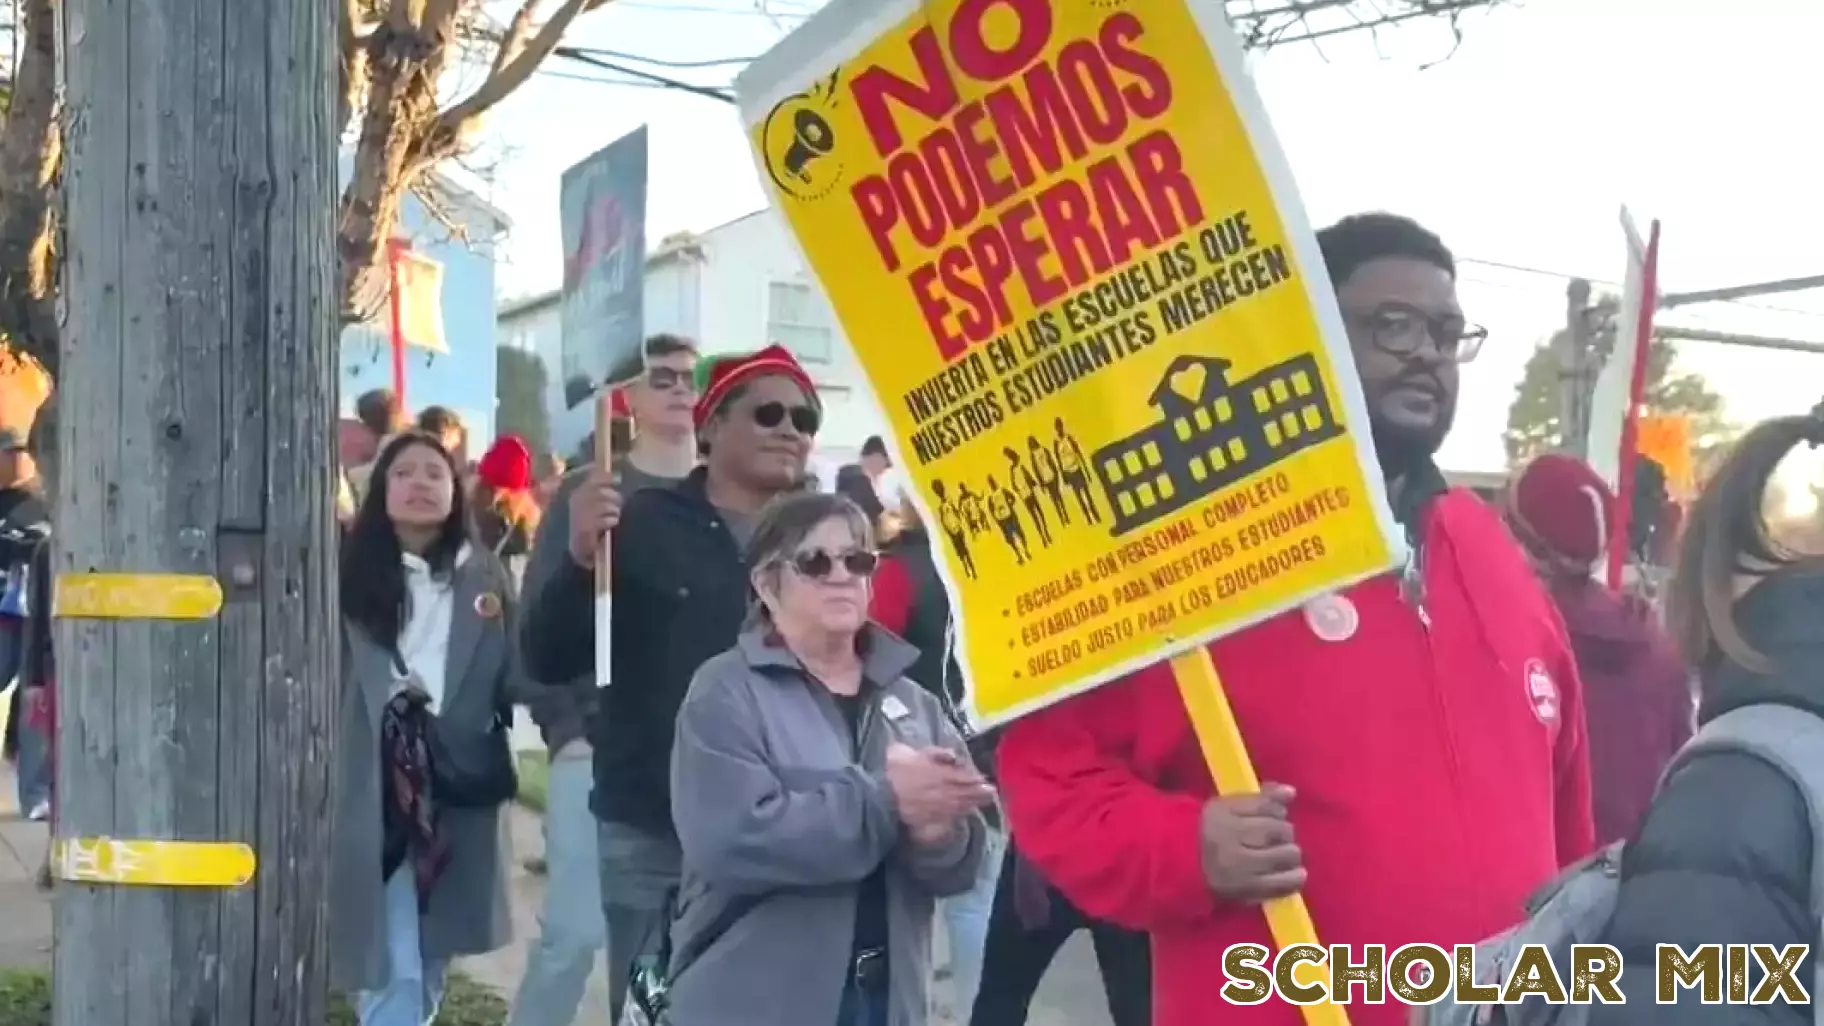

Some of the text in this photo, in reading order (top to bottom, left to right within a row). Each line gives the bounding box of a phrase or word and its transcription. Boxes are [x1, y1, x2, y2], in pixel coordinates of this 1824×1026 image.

[849, 0, 1053, 159] NO
[850, 11, 1172, 273] PODEMOS
[904, 210, 1256, 424] INVIERTA EN LAS ESCUELAS QUE
[907, 130, 1204, 364] ESPERAR
[911, 243, 1292, 465] NUESTROS ESTUDIANTES MERECEN
[1015, 472, 1290, 616] ESCUELAS CON PERSONAL COMPLETO
[1021, 486, 1350, 647] ESTABILIDAD PARA NUESTROS ESTUDIANTES
[1027, 535, 1326, 677] SUELDO JUSTO PARA LOS EDUCADORES
